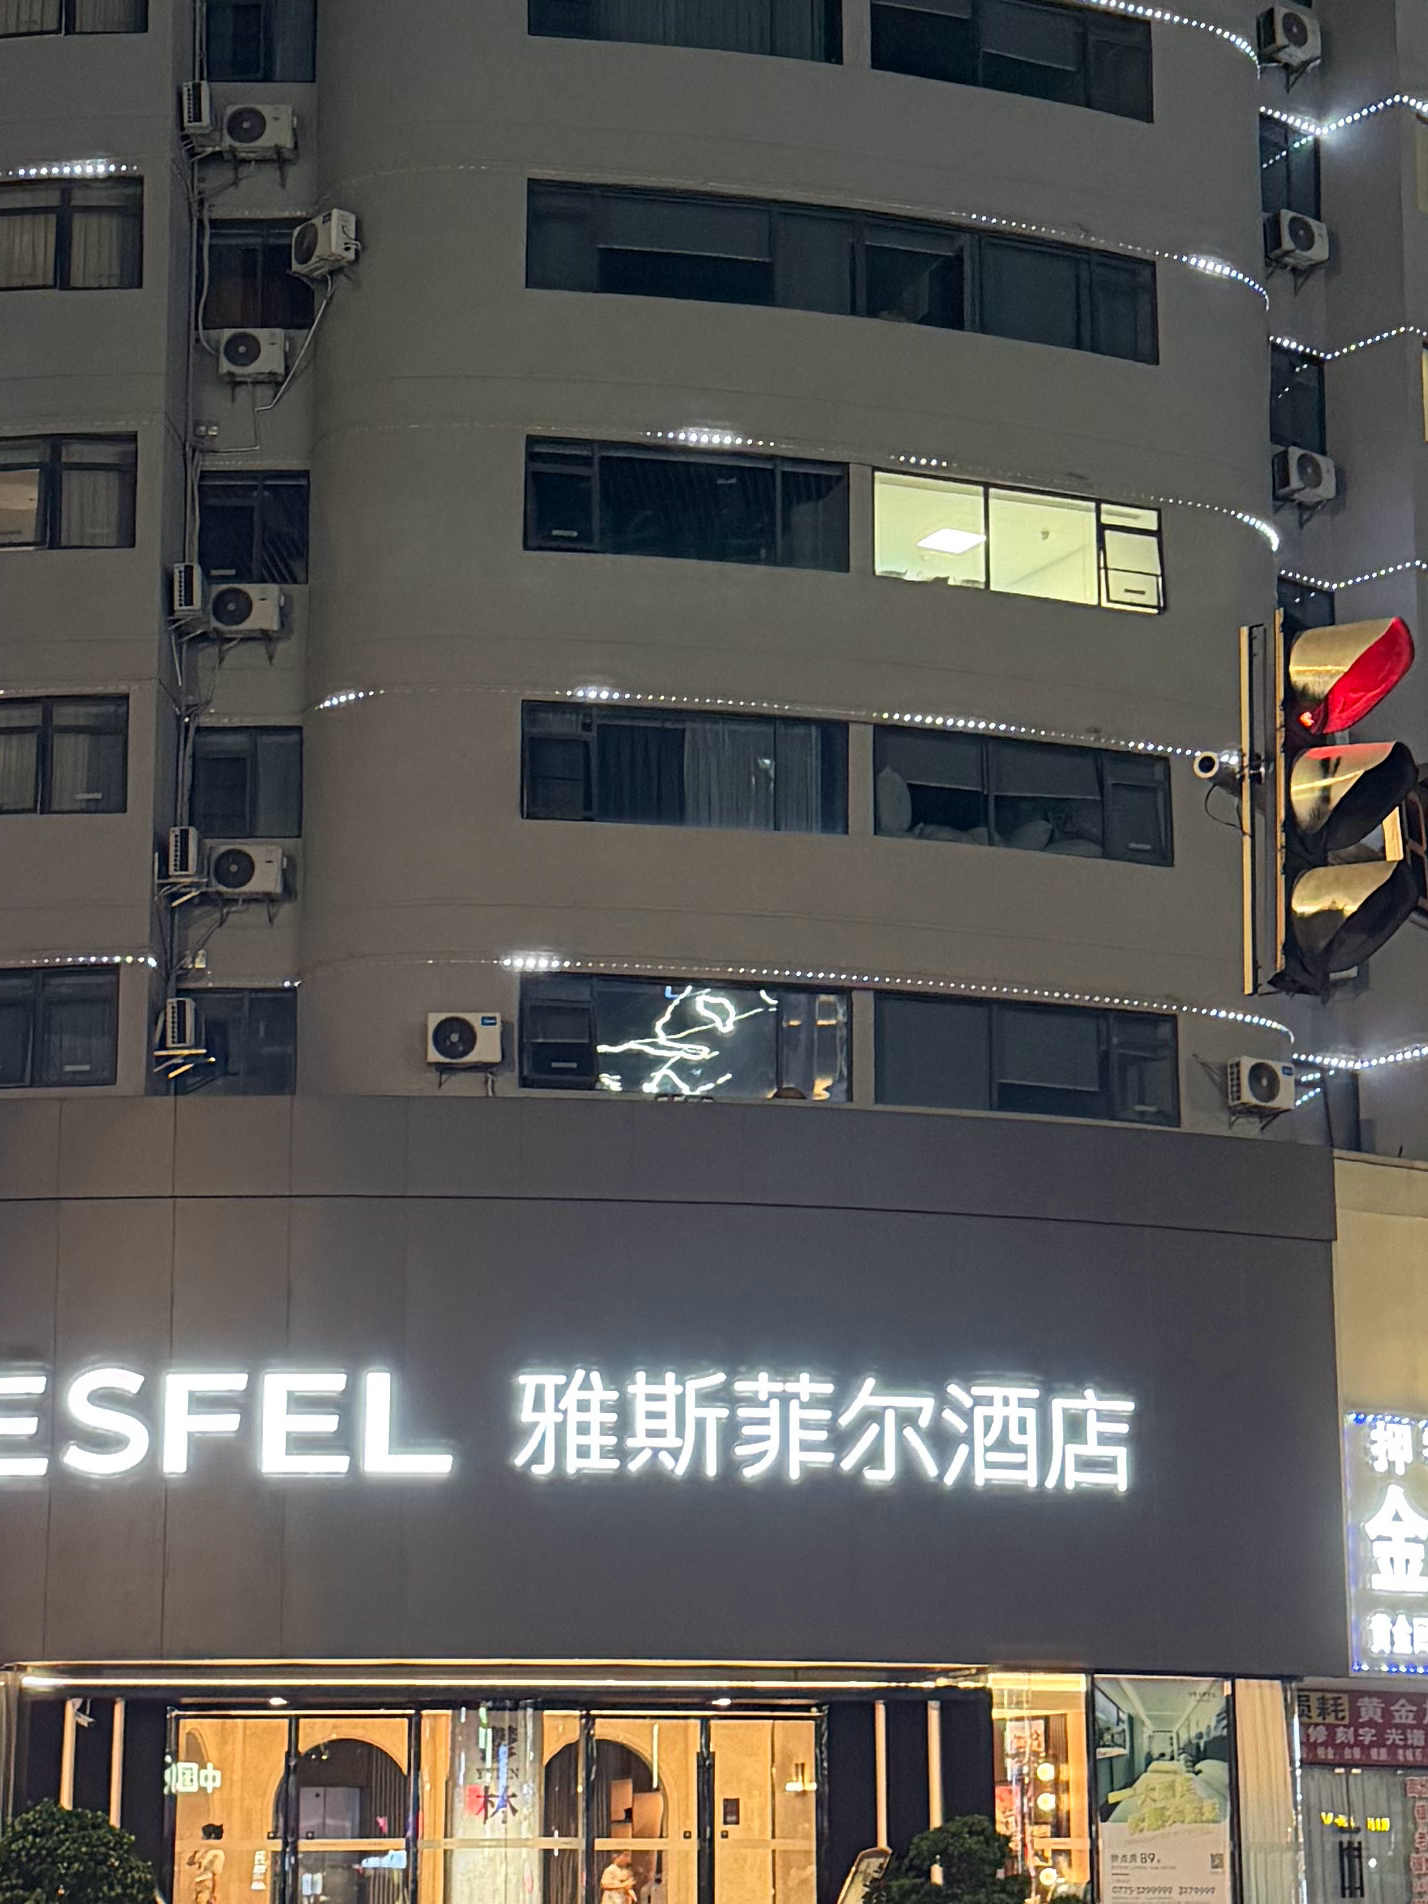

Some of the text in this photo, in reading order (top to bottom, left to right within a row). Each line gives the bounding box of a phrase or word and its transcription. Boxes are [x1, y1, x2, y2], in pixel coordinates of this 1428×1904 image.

[514, 1368, 1136, 1492] 雅斯菲尔酒店
